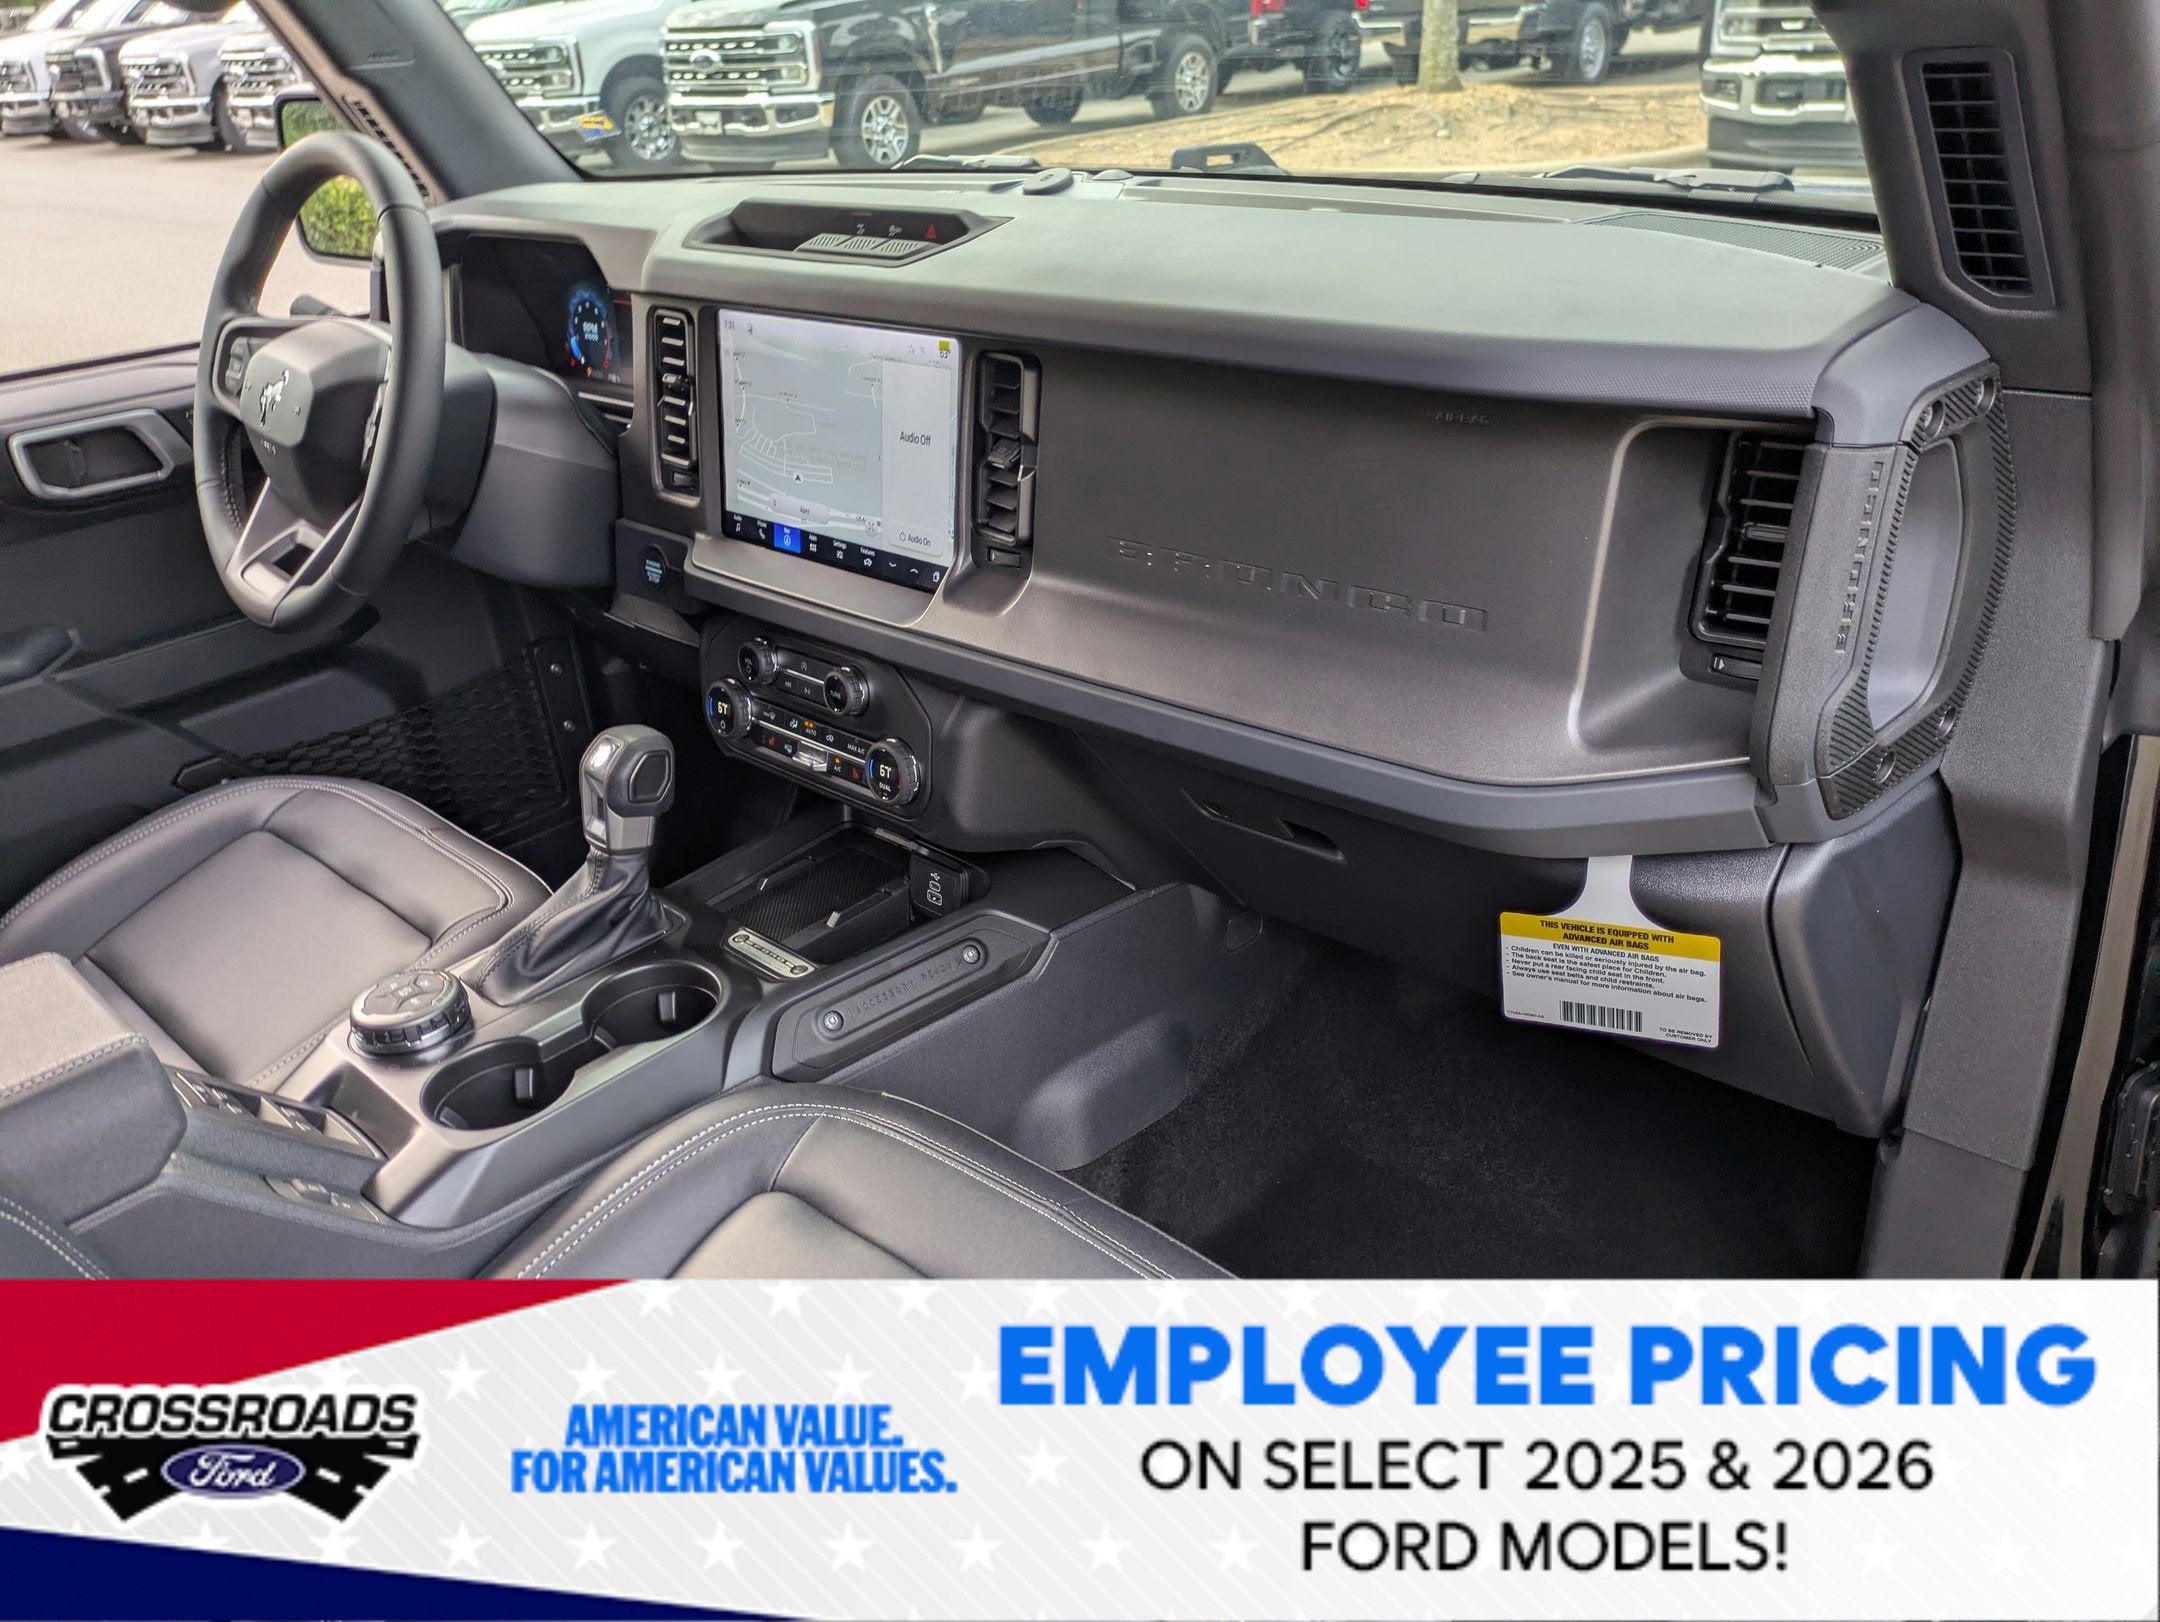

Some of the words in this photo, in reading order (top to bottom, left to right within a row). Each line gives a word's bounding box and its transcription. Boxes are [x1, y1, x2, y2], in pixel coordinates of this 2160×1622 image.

[900, 431, 919, 444] Audio
[921, 434, 931, 447] Off
[908, 534, 922, 545] Audio
[923, 537, 931, 547] On
[1835, 461, 1884, 654] BRONCO
[1106, 536, 1489, 632] BRONCO
[1540, 920, 1559, 929] THIS
[1561, 922, 1594, 933] VEHICLE
[1596, 926, 1605, 934] IS
[1607, 928, 1649, 940] EQUIPPED
[1651, 934, 1674, 943] WITH
[1563, 933, 1607, 945] ADVANCED
[1609, 938, 1624, 946] AIR
[1626, 940, 1649, 950] BAGS
[1511, 945, 1540, 954] Children
[1565, 952, 1583, 960] killed
[1594, 957, 1626, 967] seriously
[1628, 960, 1653, 969] injured
[1655, 964, 1663, 972] by
[1690, 968, 1706, 977] bag.
[1553, 943, 1570, 951] EVEN
[1571, 945, 1588, 953] WITH
[1590, 947, 1626, 957] ADVANCED
[1641, 954, 1659, 962] BAGS
[1512, 958, 1531, 966] Never
[1566, 964, 1587, 974] facing
[1632, 973, 1644, 981] the
[1646, 975, 1665, 984] front.
[1512, 964, 1535, 973] Always
[1567, 971, 1583, 979] belts
[1600, 975, 1617, 984] child
[1526, 953, 1541, 961] back
[1579, 960, 1600, 968] safest
[1602, 962, 1620, 971] place
[1634, 968, 1666, 978] Children.
[1526, 973, 1552, 981] owner's
[1554, 977, 1579, 985] manual
[1611, 983, 1652, 995] information
[1653, 990, 1674, 998] about
[1687, 994, 1707, 1003] bags.
[1665, 1032, 1696, 1041] CUSTOMER
